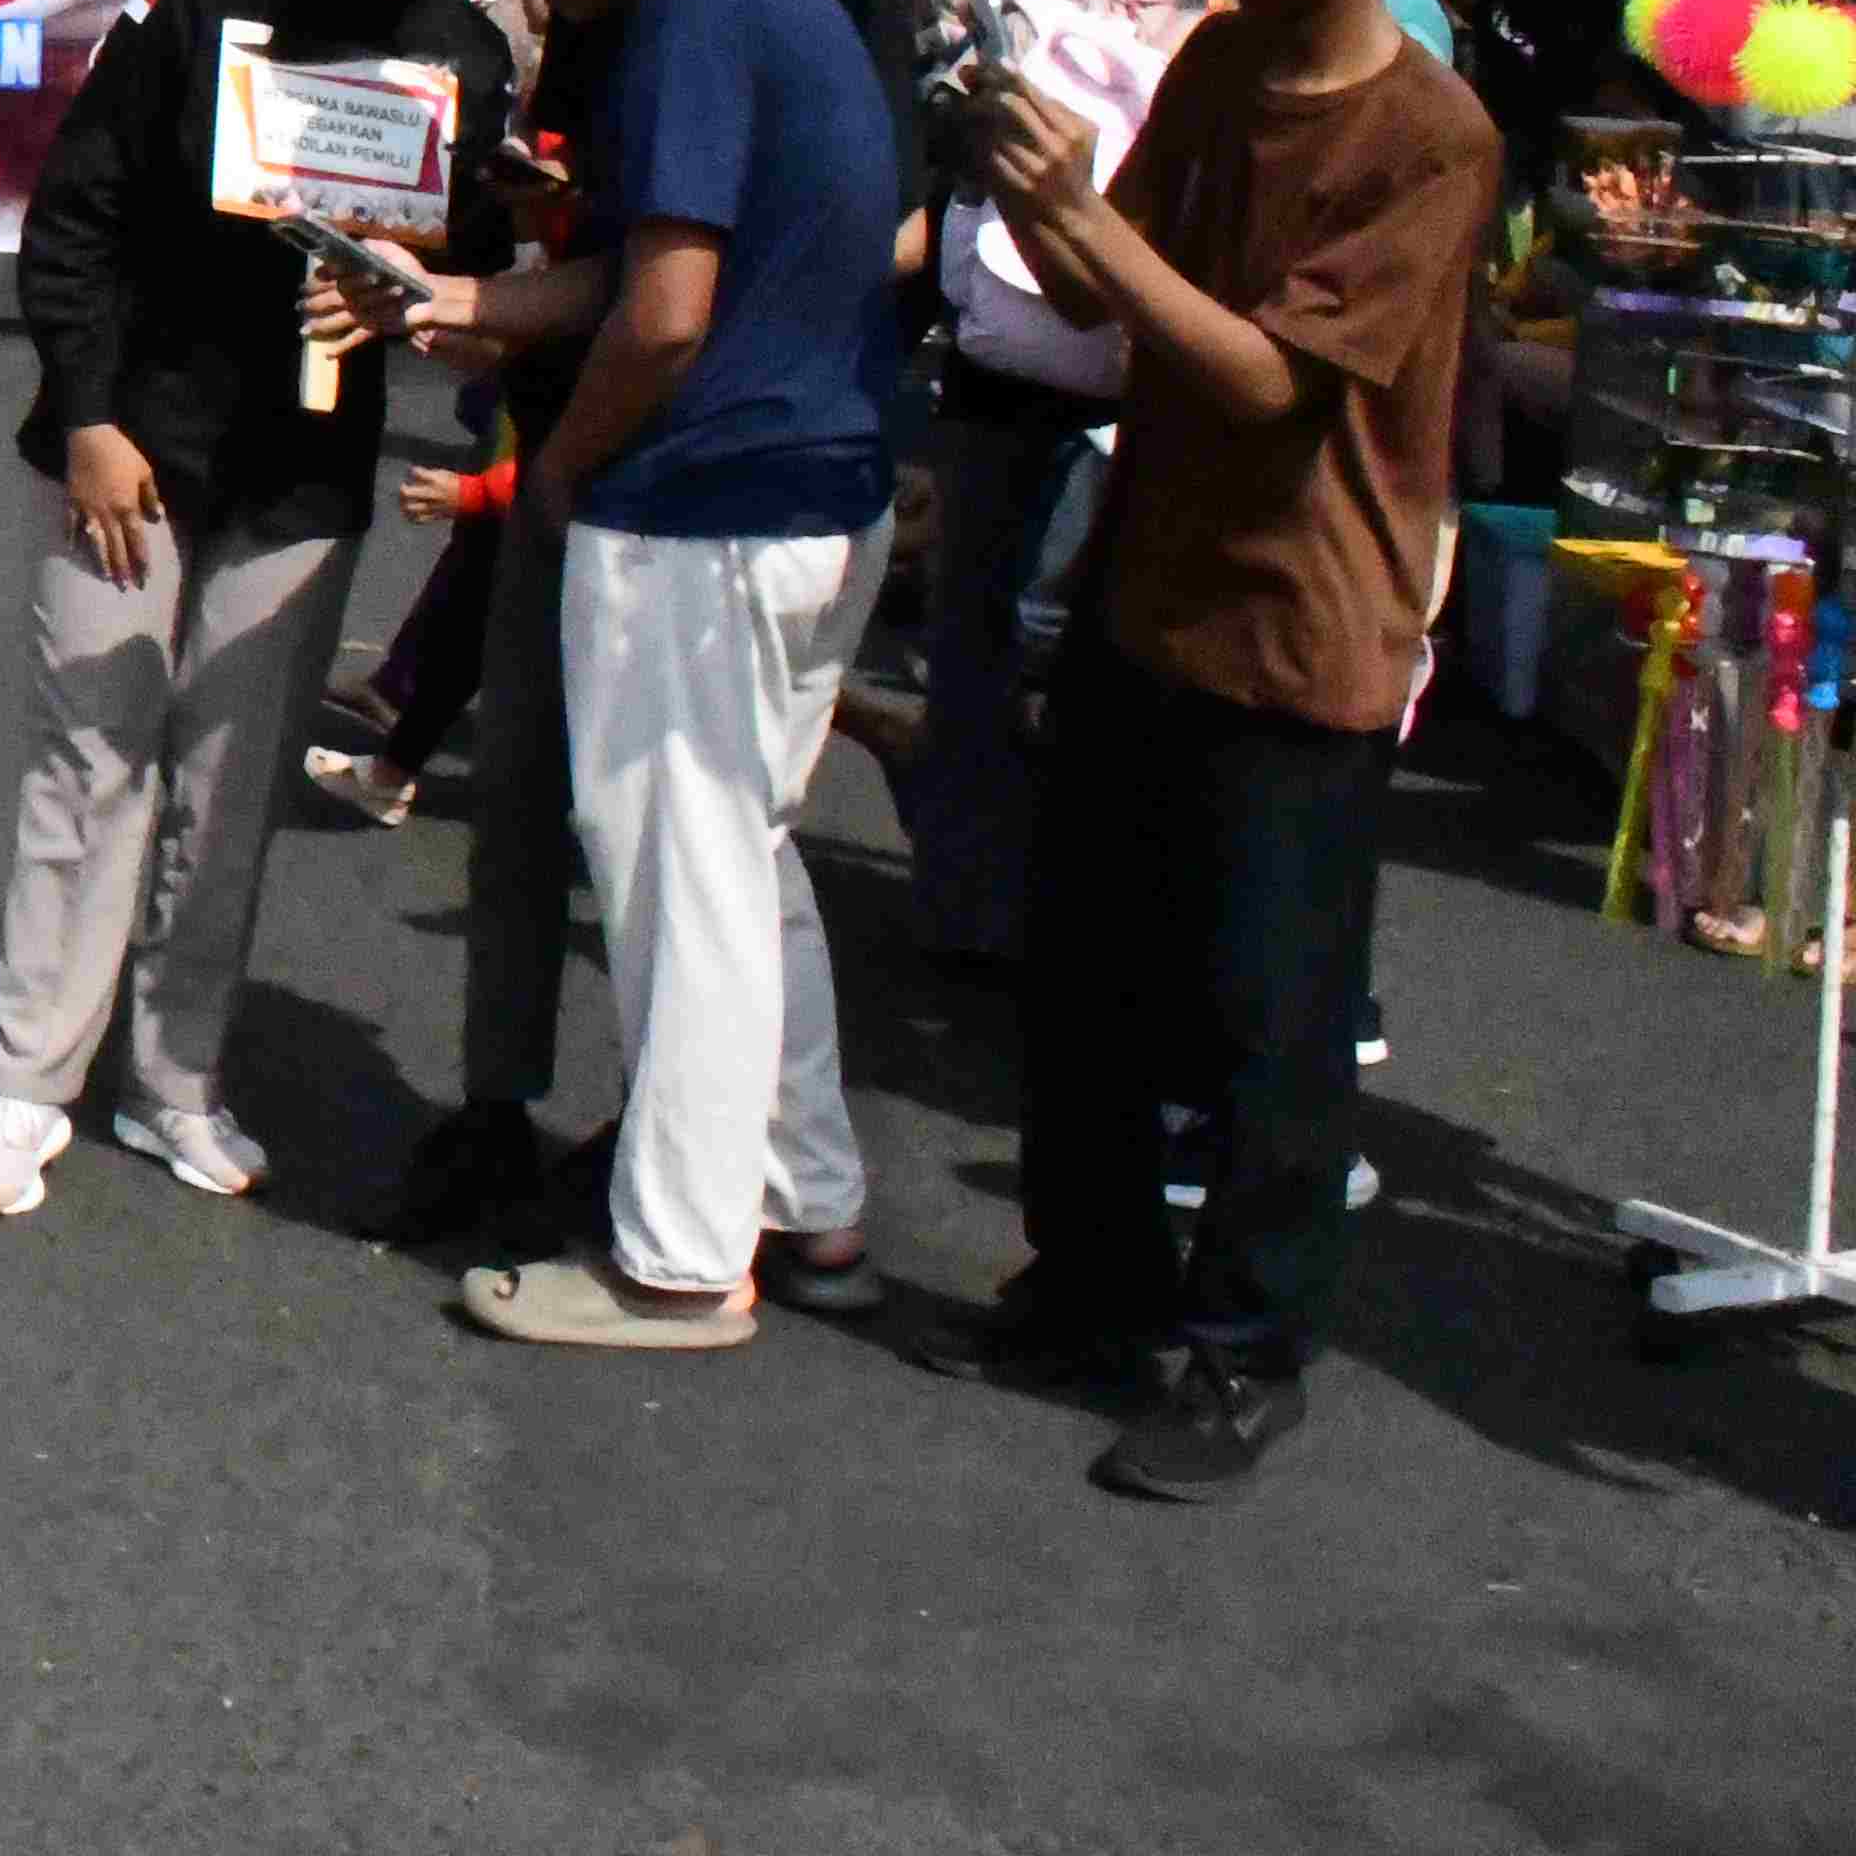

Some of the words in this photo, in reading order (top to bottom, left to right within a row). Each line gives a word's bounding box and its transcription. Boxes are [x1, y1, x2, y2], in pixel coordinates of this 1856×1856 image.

[344, 101, 422, 128] BAWASLU
[305, 116, 383, 142] EGAKKAN
[352, 146, 411, 170] PEMILU
